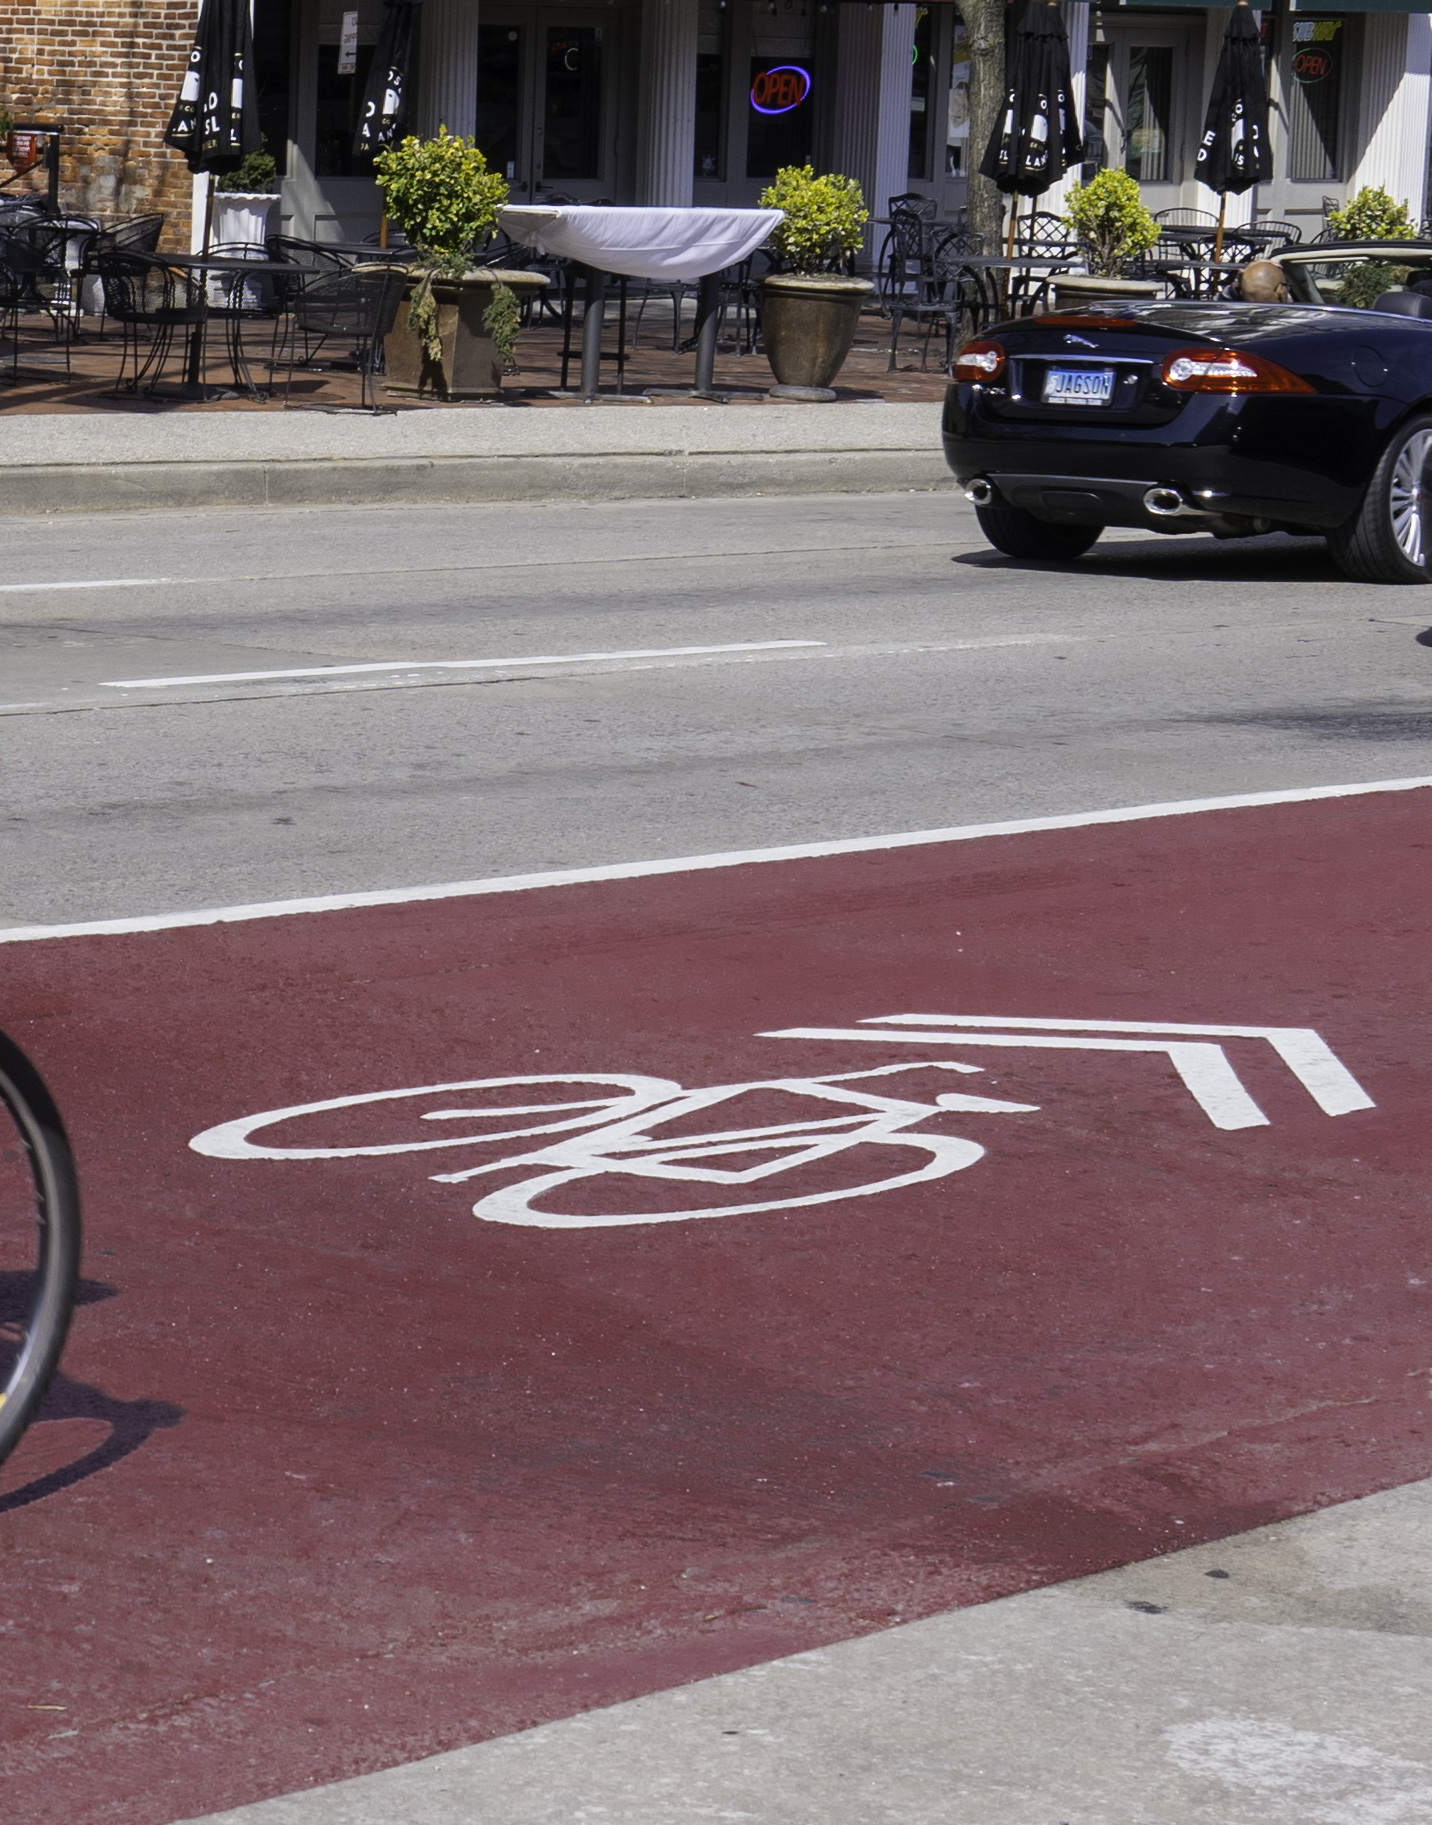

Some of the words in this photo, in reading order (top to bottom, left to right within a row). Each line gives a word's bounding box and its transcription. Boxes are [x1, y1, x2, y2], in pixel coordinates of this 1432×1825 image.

[1294, 54, 1327, 76] OPEN
[752, 71, 805, 107] OPEN
[1055, 374, 1111, 396] JAGSON
